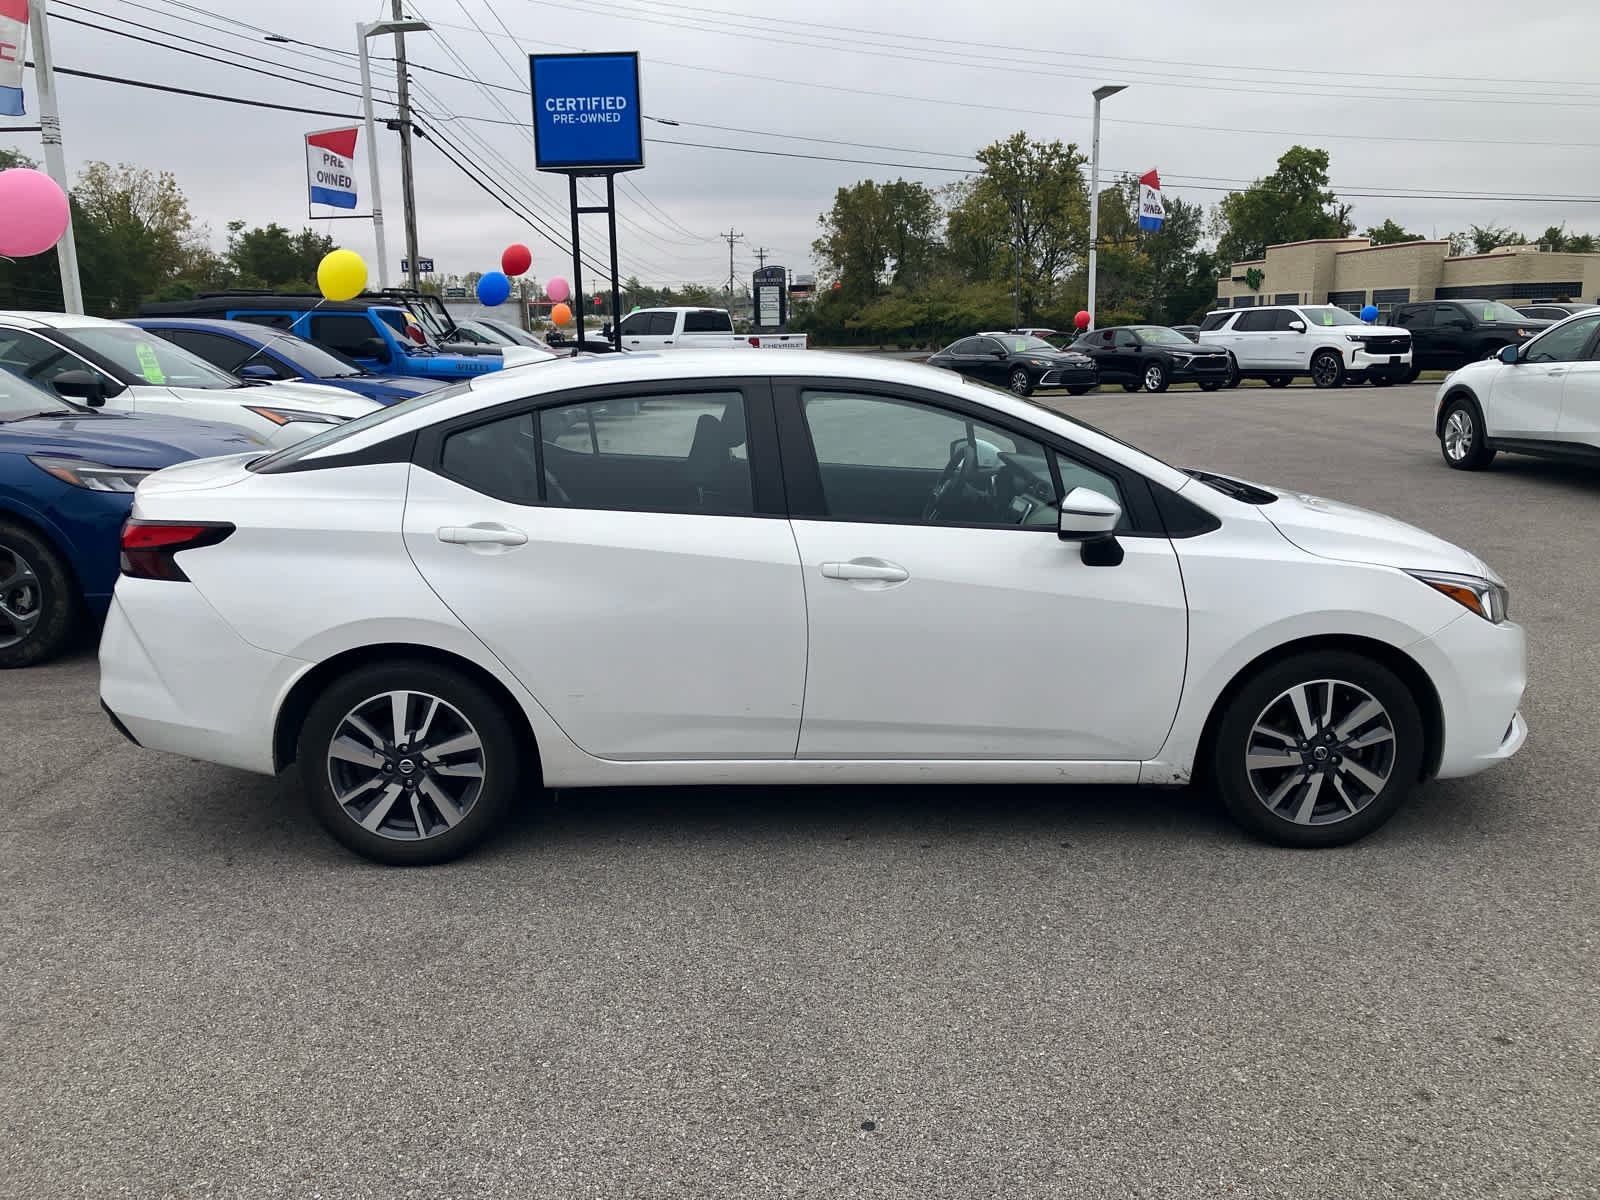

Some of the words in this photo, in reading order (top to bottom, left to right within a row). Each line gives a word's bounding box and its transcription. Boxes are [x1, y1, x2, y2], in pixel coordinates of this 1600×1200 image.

[545, 96, 627, 111] CERTIFIED
[553, 112, 621, 124] PRE-OWNED
[323, 153, 344, 168] PRE
[317, 170, 352, 188] OWNED
